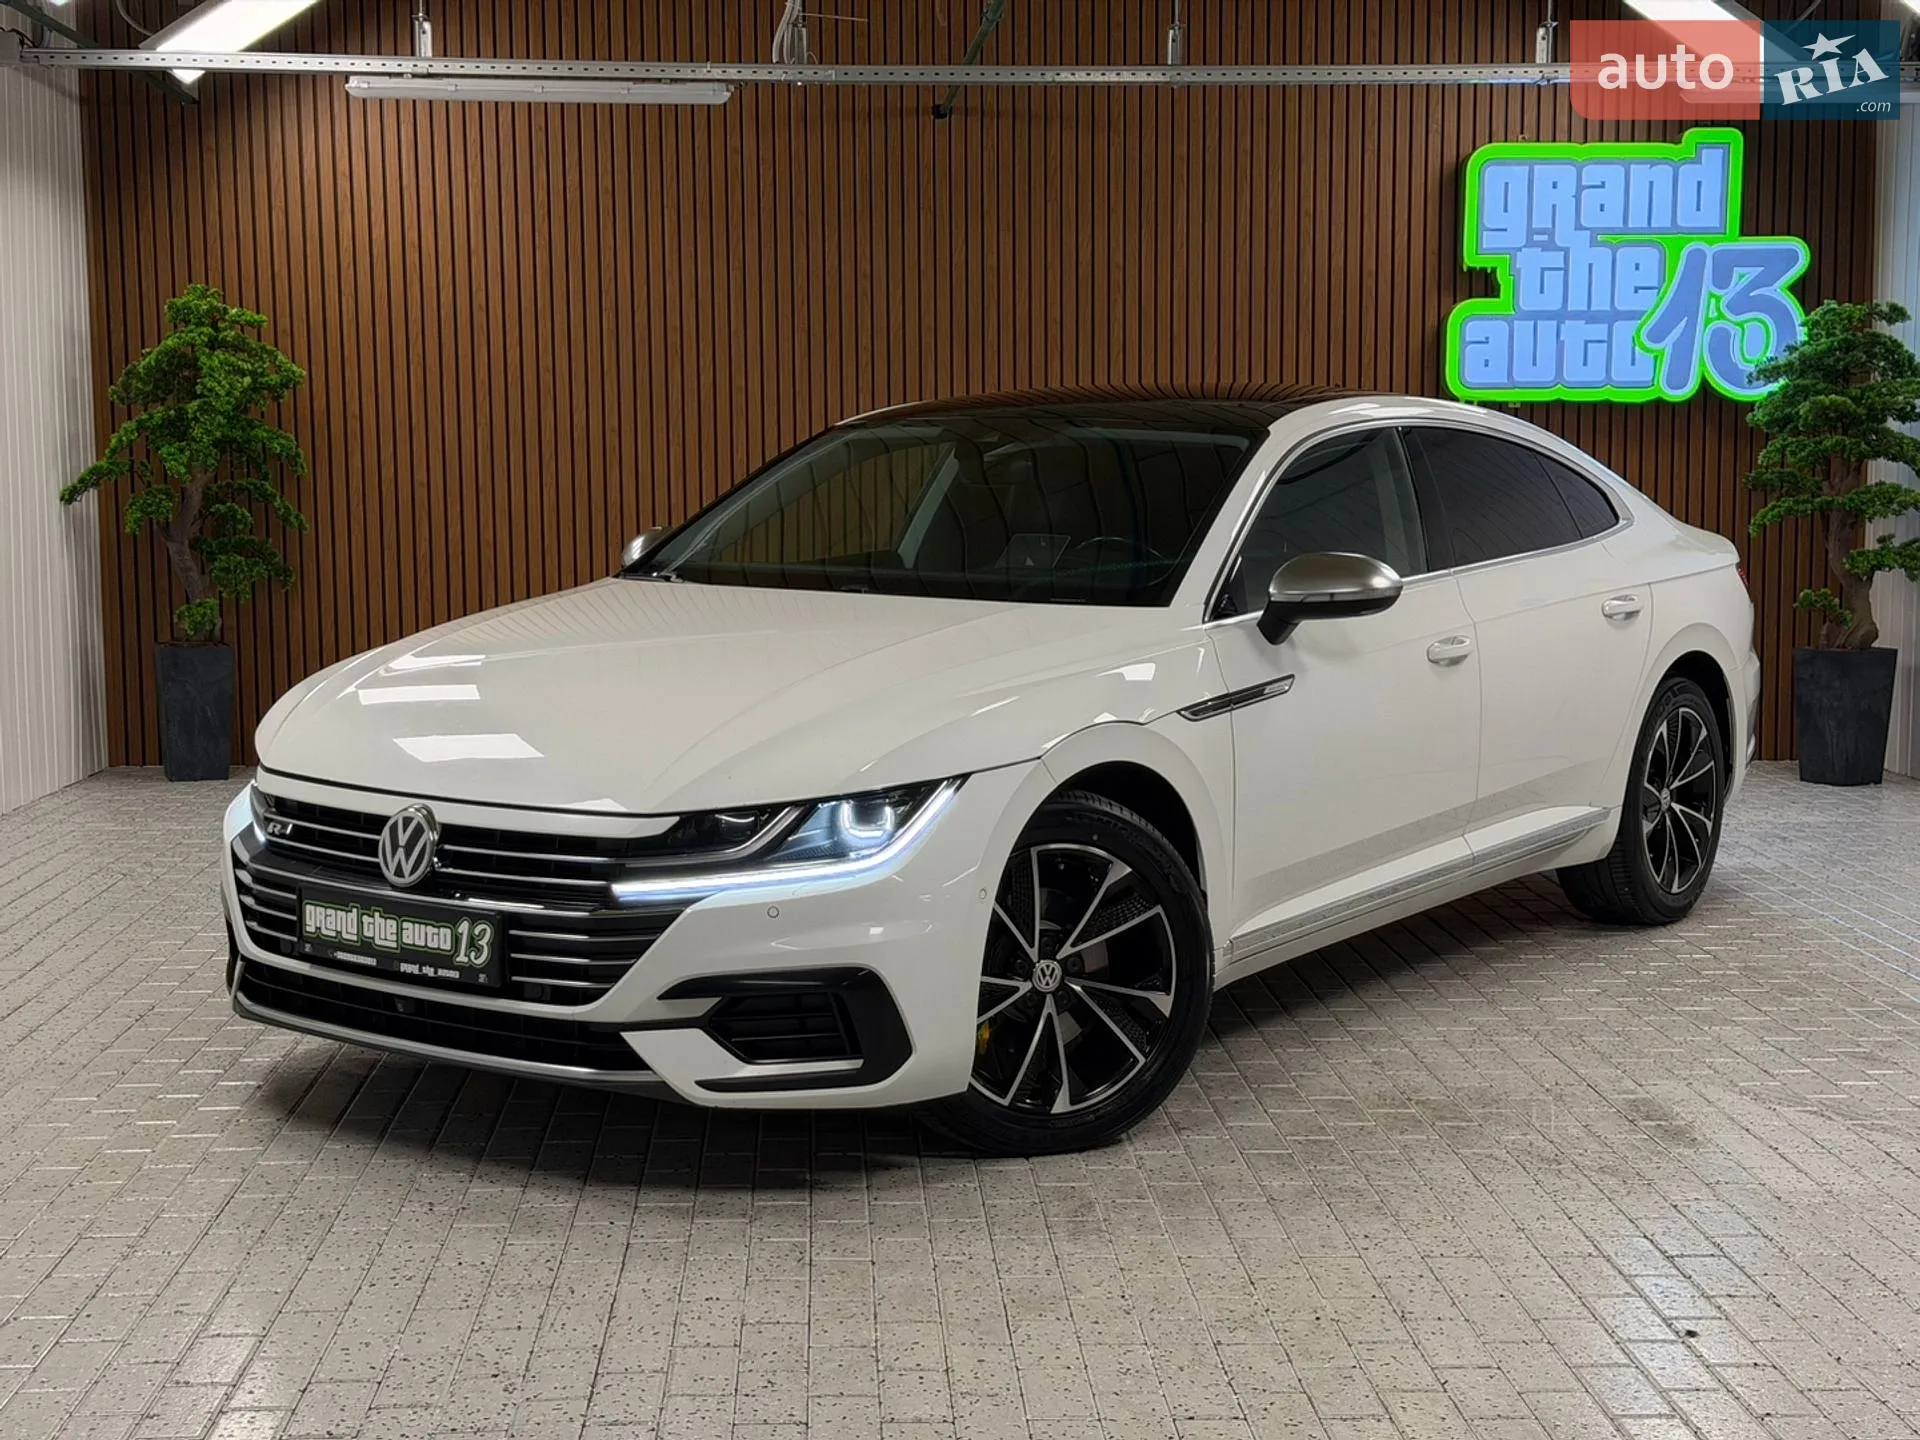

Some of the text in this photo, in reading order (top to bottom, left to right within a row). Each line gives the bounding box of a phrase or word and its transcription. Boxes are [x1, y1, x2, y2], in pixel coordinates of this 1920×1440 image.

[1516, 232, 1661, 311] the
[1643, 243, 1804, 394] 13
[362, 913, 398, 947] the
[402, 923, 452, 950] auto
[456, 920, 493, 964] 13
